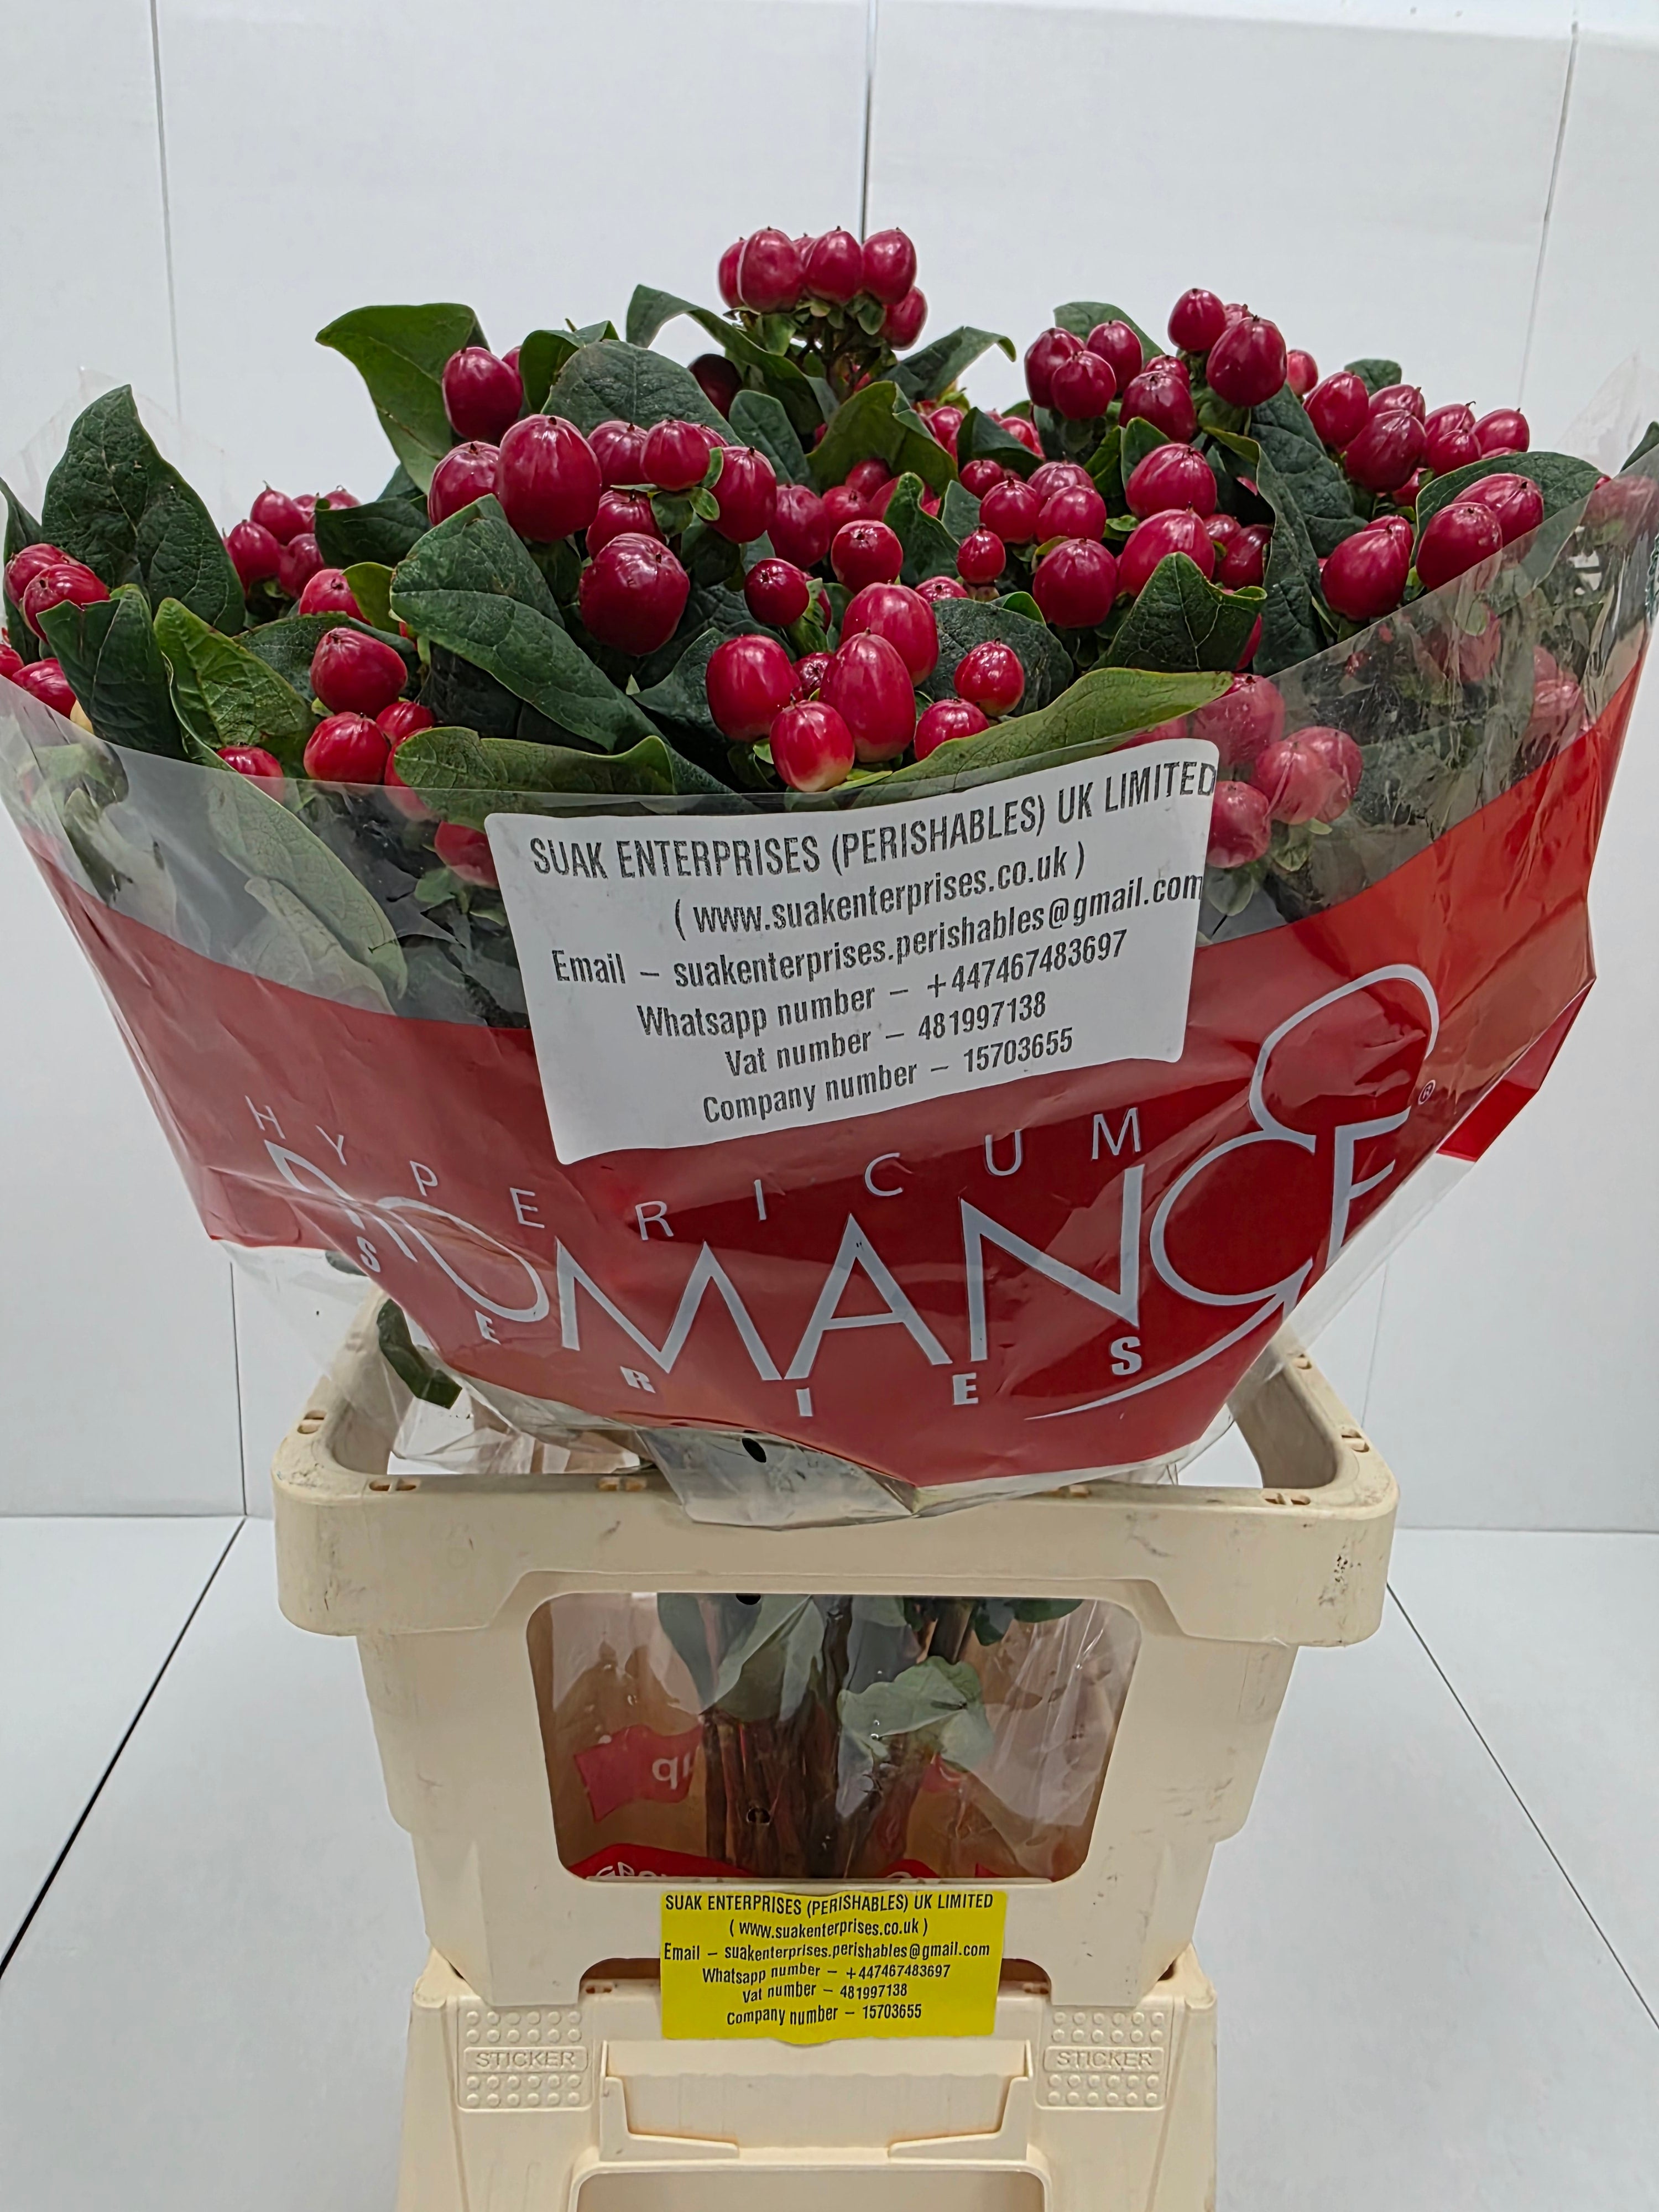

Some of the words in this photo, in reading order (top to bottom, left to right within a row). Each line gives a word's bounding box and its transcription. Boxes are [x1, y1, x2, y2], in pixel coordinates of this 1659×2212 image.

[530, 837, 608, 880] SUAK
[618, 833, 820, 879] ENTERPRISES
[832, 794, 1045, 875] (PERISHABLES)
[1058, 782, 1093, 824] UK
[1105, 761, 1217, 813] LIMITED
[694, 846, 1068, 933] www.suakenterprises.co.uk
[551, 950, 627, 984] Email
[674, 874, 1203, 987] suakenterprises.perishables@gmail.com
[637, 1005, 766, 1040] Whatsapp
[778, 989, 875, 1027] number
[927, 929, 1126, 998] +447467483697
[725, 1047, 766, 1077] Vat
[776, 1032, 871, 1071] number
[918, 991, 1046, 1041] 481997138
[703, 1083, 816, 1123] Company
[826, 1062, 917, 1102] number
[964, 1027, 1073, 1073] 15703655
[245, 1095, 1142, 1241] HYPERICUM
[665, 1895, 702, 1910] SUAK
[708, 1895, 801, 1915] ENTERPRISES
[807, 1894, 909, 1918] (PERISHABLES)
[914, 1894, 933, 1909] UK
[938, 1893, 993, 1909] LIMITED
[739, 1918, 919, 1939] www.suakenterprises.co.uk
[664, 1943, 700, 1961] Email
[725, 1942, 990, 1961] suakenterprises.perishables@gmail.com
[702, 1968, 766, 1985] Whatsapp
[771, 1963, 820, 1978] number
[846, 1964, 951, 1979] +447467483697
[743, 1987, 762, 2003] Vat
[768, 1981, 816, 1998] number
[841, 1983, 907, 2000] 481997138
[727, 2008, 785, 2026] Company
[790, 2005, 838, 2025] number
[863, 2004, 922, 2019] 15703655
[476, 2051, 575, 2067] STICKER
[1057, 2051, 1152, 2067] STICKER
